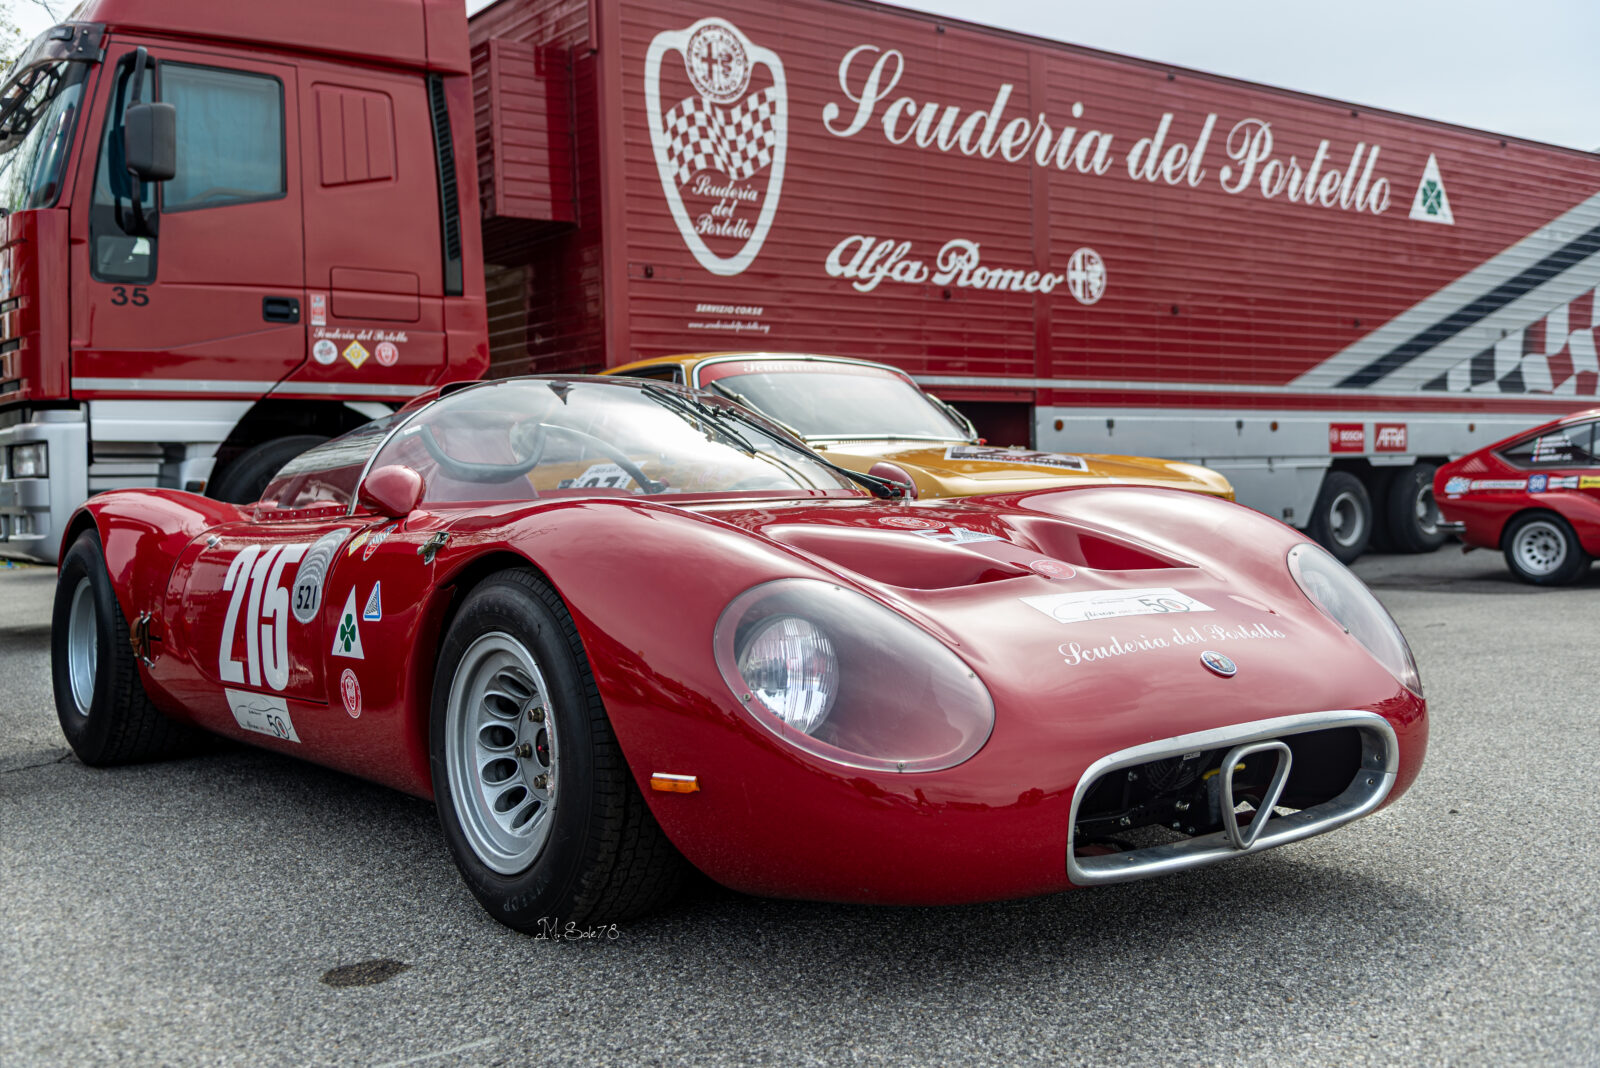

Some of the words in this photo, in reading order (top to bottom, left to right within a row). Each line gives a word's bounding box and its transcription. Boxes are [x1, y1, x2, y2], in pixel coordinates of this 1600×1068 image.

[823, 45, 1113, 175] Scuderia
[1127, 113, 1217, 188] del
[1220, 118, 1390, 215] Portello
[692, 175, 758, 202] Scuderia
[711, 198, 738, 218] del
[695, 213, 753, 238] Portello
[825, 235, 929, 292] Alfa
[932, 239, 1063, 293] Romeo
[111, 286, 150, 306] 35
[297, 585, 317, 610] 521
[1137, 598, 1191, 613] 50
[219, 543, 310, 691] 215
[1058, 635, 1170, 665] Scuderia
[1173, 627, 1206, 646] del
[1203, 624, 1286, 641] Portello
[266, 713, 290, 740] 50
